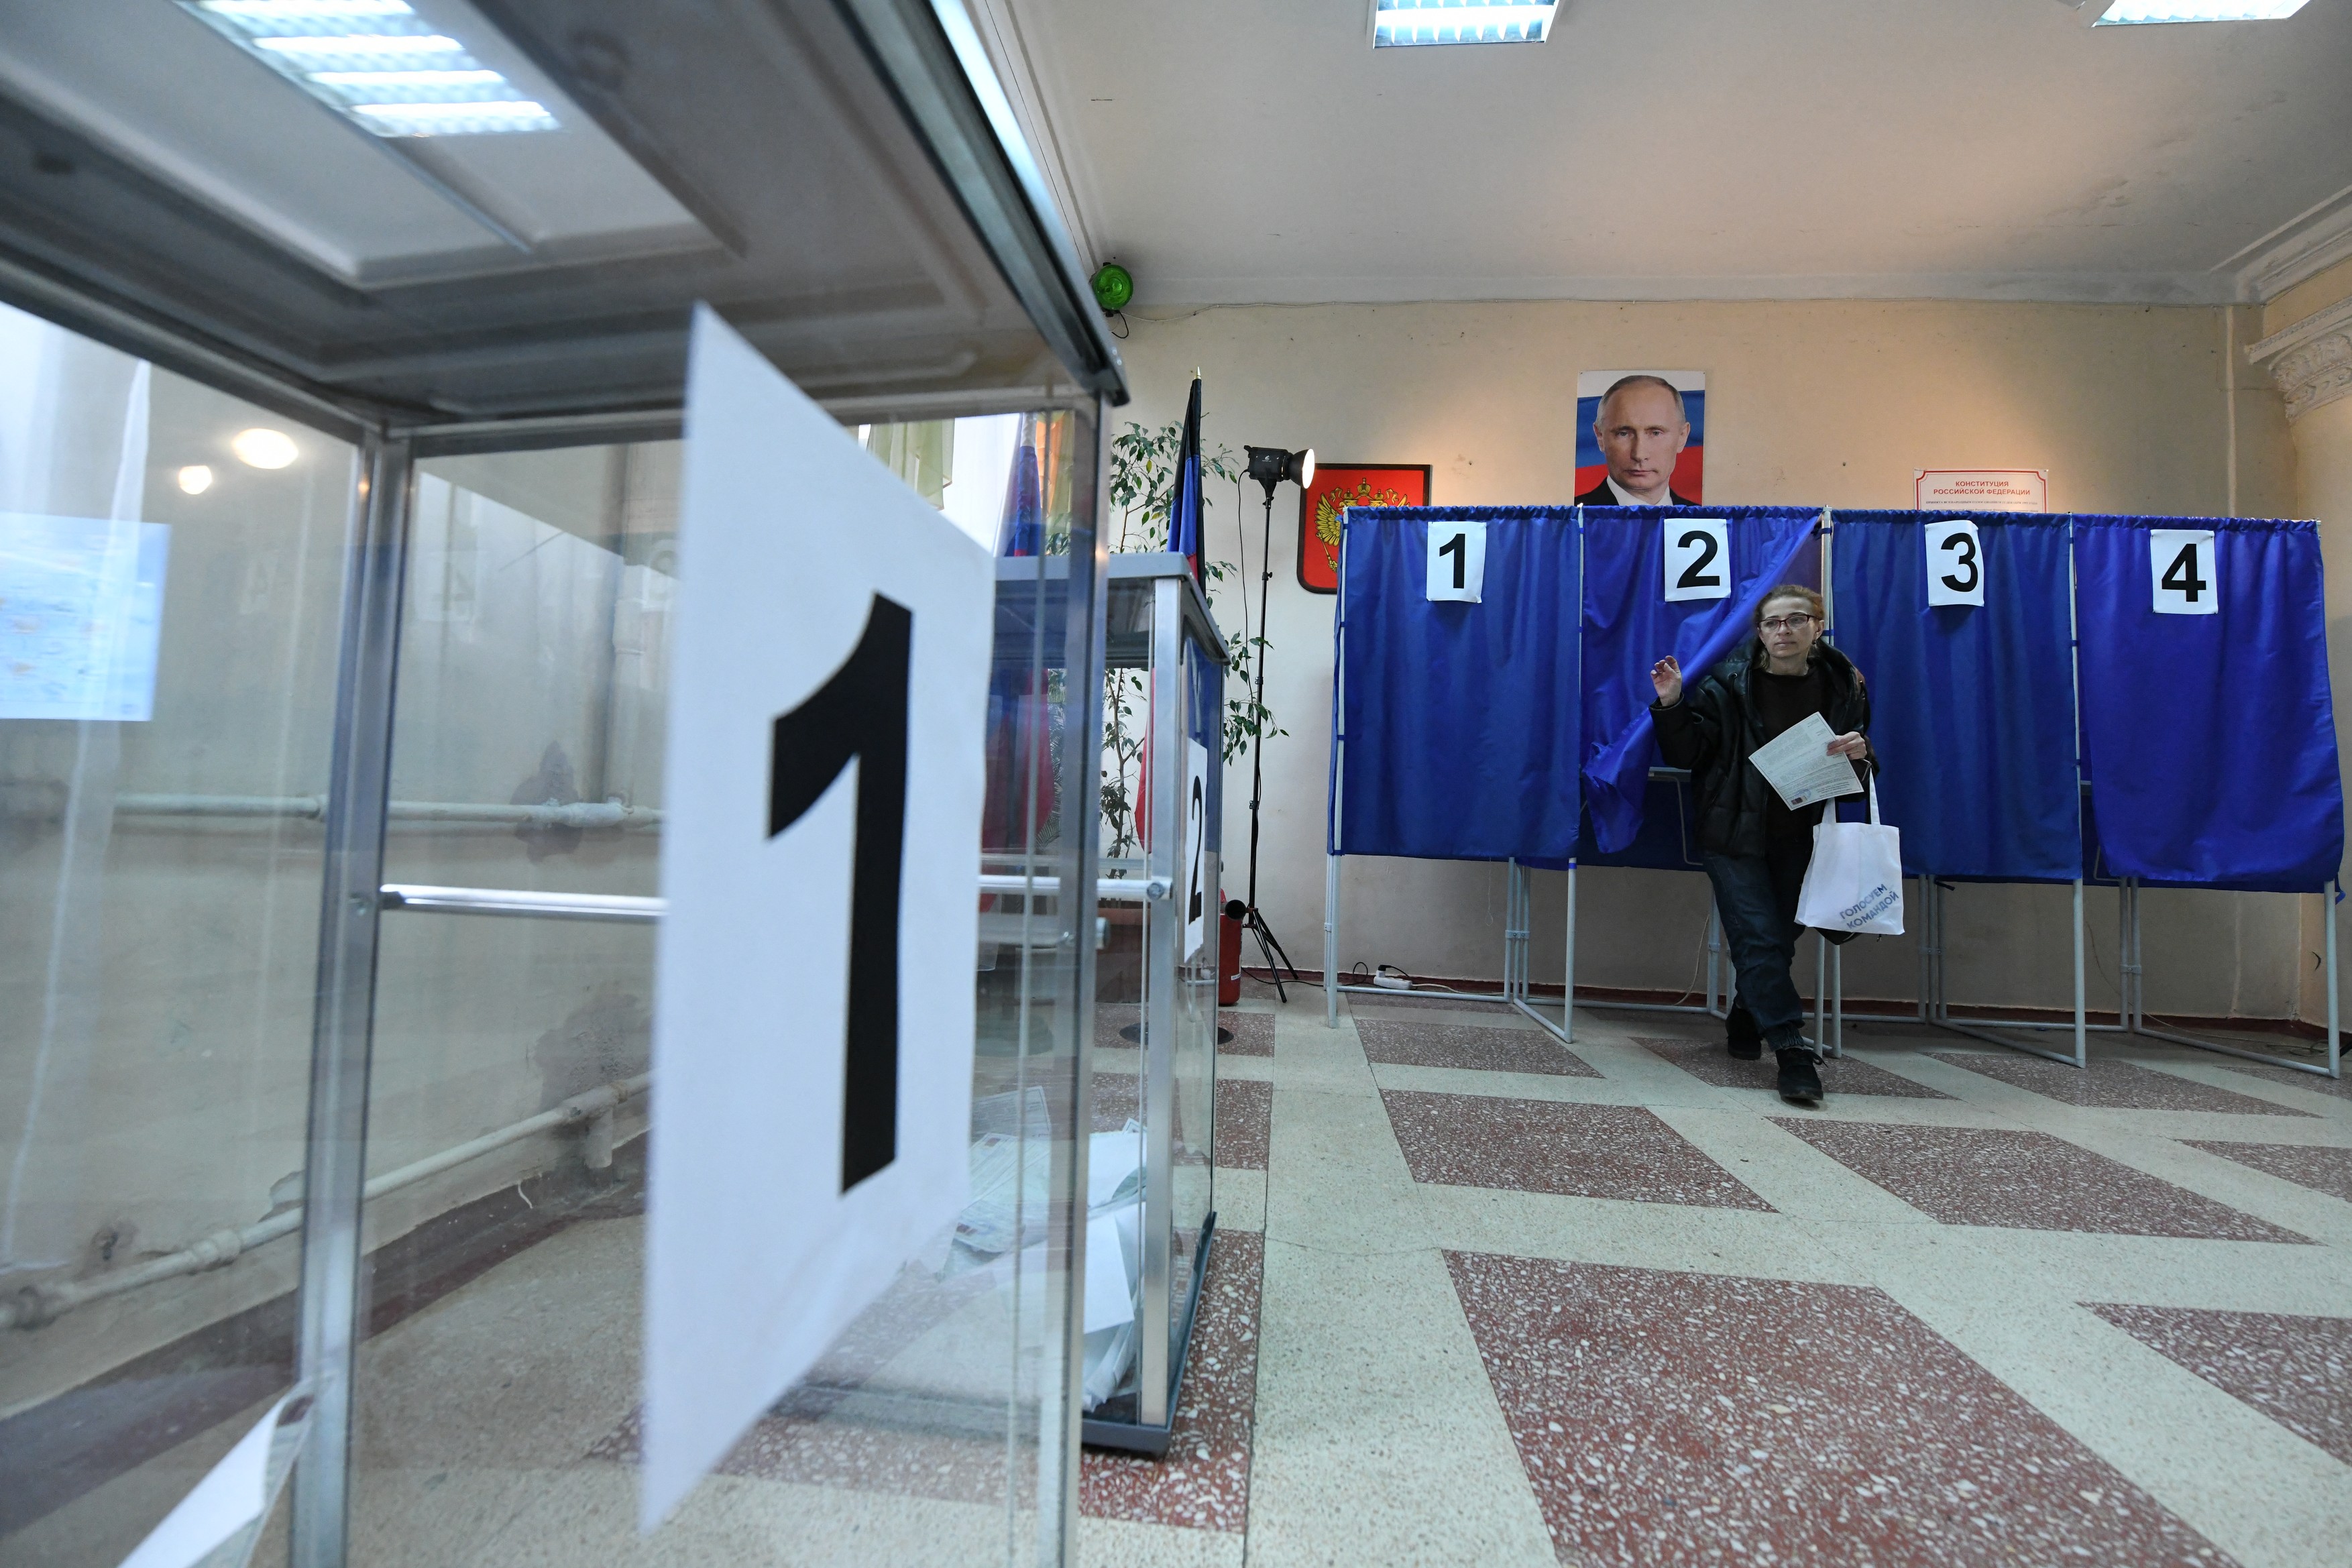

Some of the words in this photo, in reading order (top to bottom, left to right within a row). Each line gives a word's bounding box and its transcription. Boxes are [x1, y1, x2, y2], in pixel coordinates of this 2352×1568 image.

[1439, 533, 1465, 589] 1
[1677, 530, 1720, 588] 2
[1941, 533, 1978, 592] 3
[2162, 543, 2206, 602] 4
[1188, 775, 1202, 925] 2
[767, 590, 913, 1195] 1
[1840, 883, 1888, 919] ГОЛОСУЕМ
[1847, 891, 1899, 930] КОМАНДОЙ
